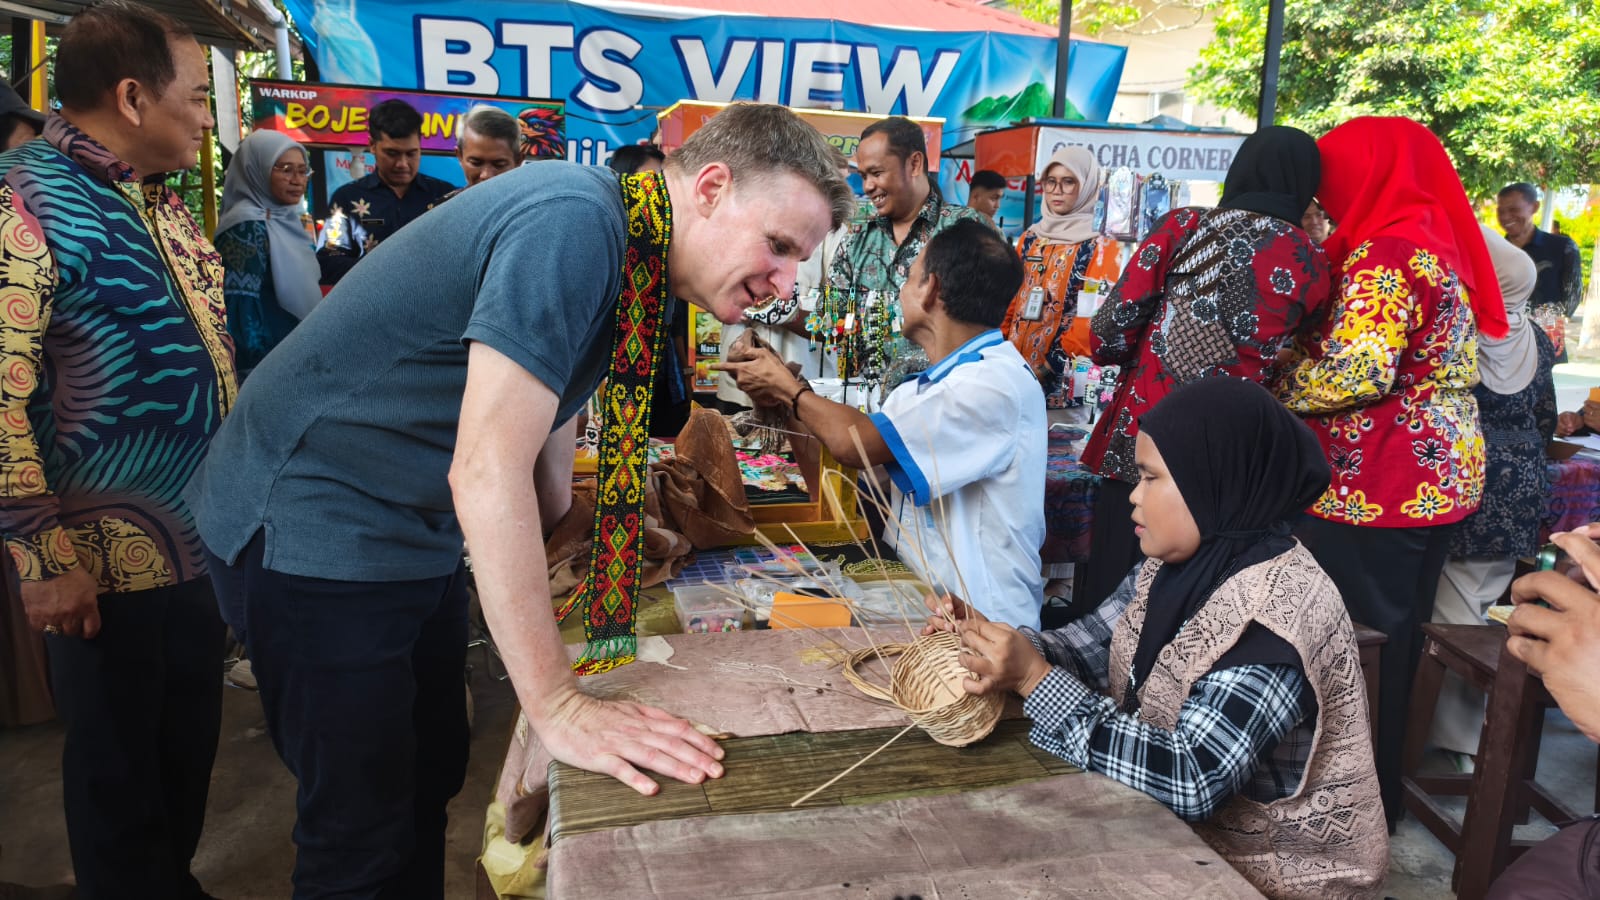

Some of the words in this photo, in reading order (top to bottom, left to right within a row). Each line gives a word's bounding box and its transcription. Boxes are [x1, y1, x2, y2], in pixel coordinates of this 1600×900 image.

[415, 15, 645, 114] BTS
[671, 36, 961, 117] VIEW
[259, 87, 318, 100] WARKOP
[284, 102, 370, 133] BOJE
[1052, 142, 1141, 169] CHA
[1147, 145, 1233, 171] CORNER
[700, 344, 717, 353] Nasi
